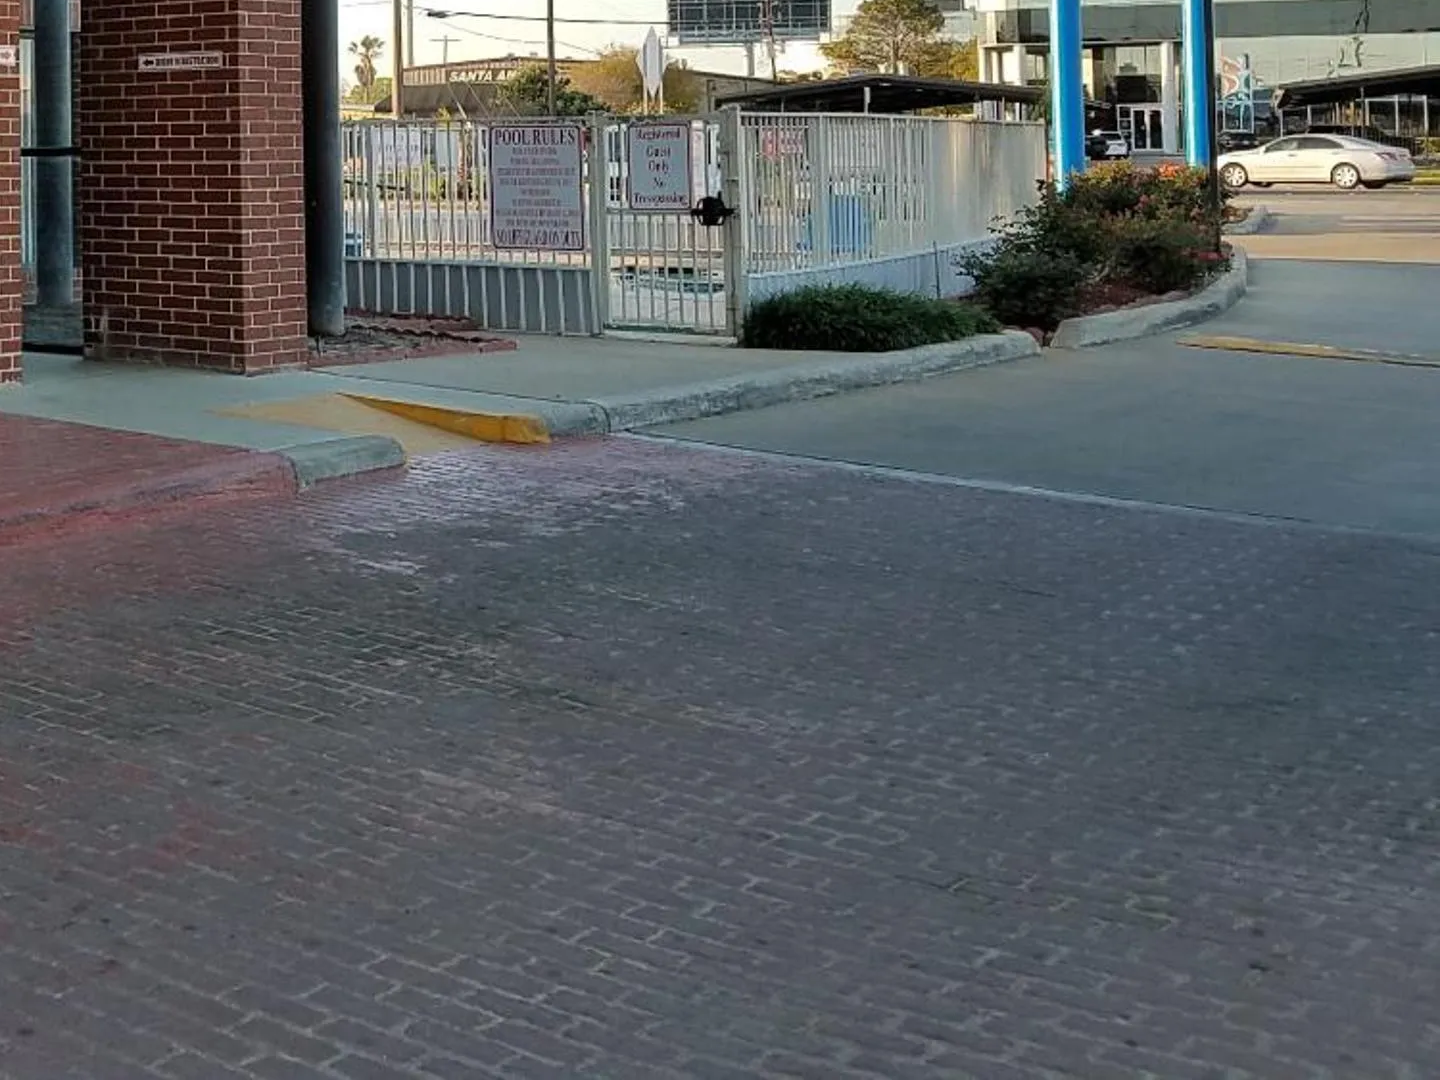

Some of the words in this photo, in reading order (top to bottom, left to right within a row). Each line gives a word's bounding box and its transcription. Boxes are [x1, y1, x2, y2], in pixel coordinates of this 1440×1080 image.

[449, 70, 493, 82] SANTA
[495, 129, 530, 146] POOL
[533, 129, 576, 146] RULES
